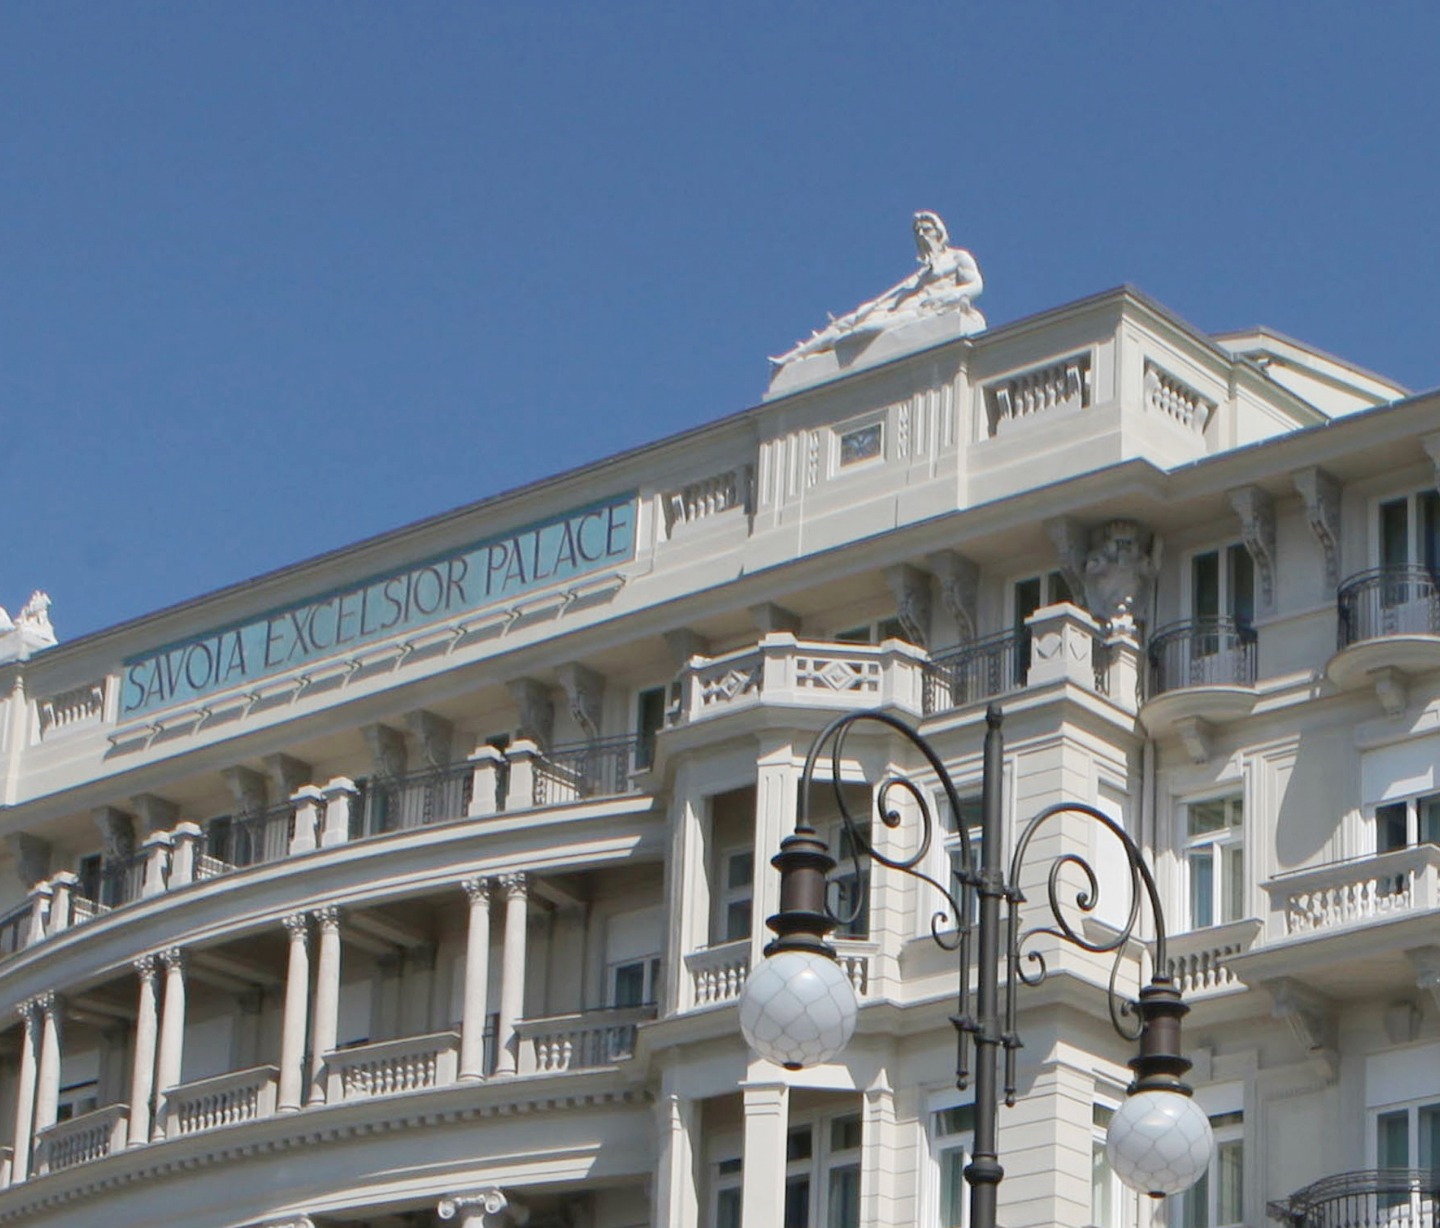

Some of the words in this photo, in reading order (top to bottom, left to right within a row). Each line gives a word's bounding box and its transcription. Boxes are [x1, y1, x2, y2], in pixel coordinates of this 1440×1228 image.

[124, 631, 246, 712] SAVOIA
[264, 557, 467, 669] EXCELSIOR
[486, 501, 629, 596] PALACE
